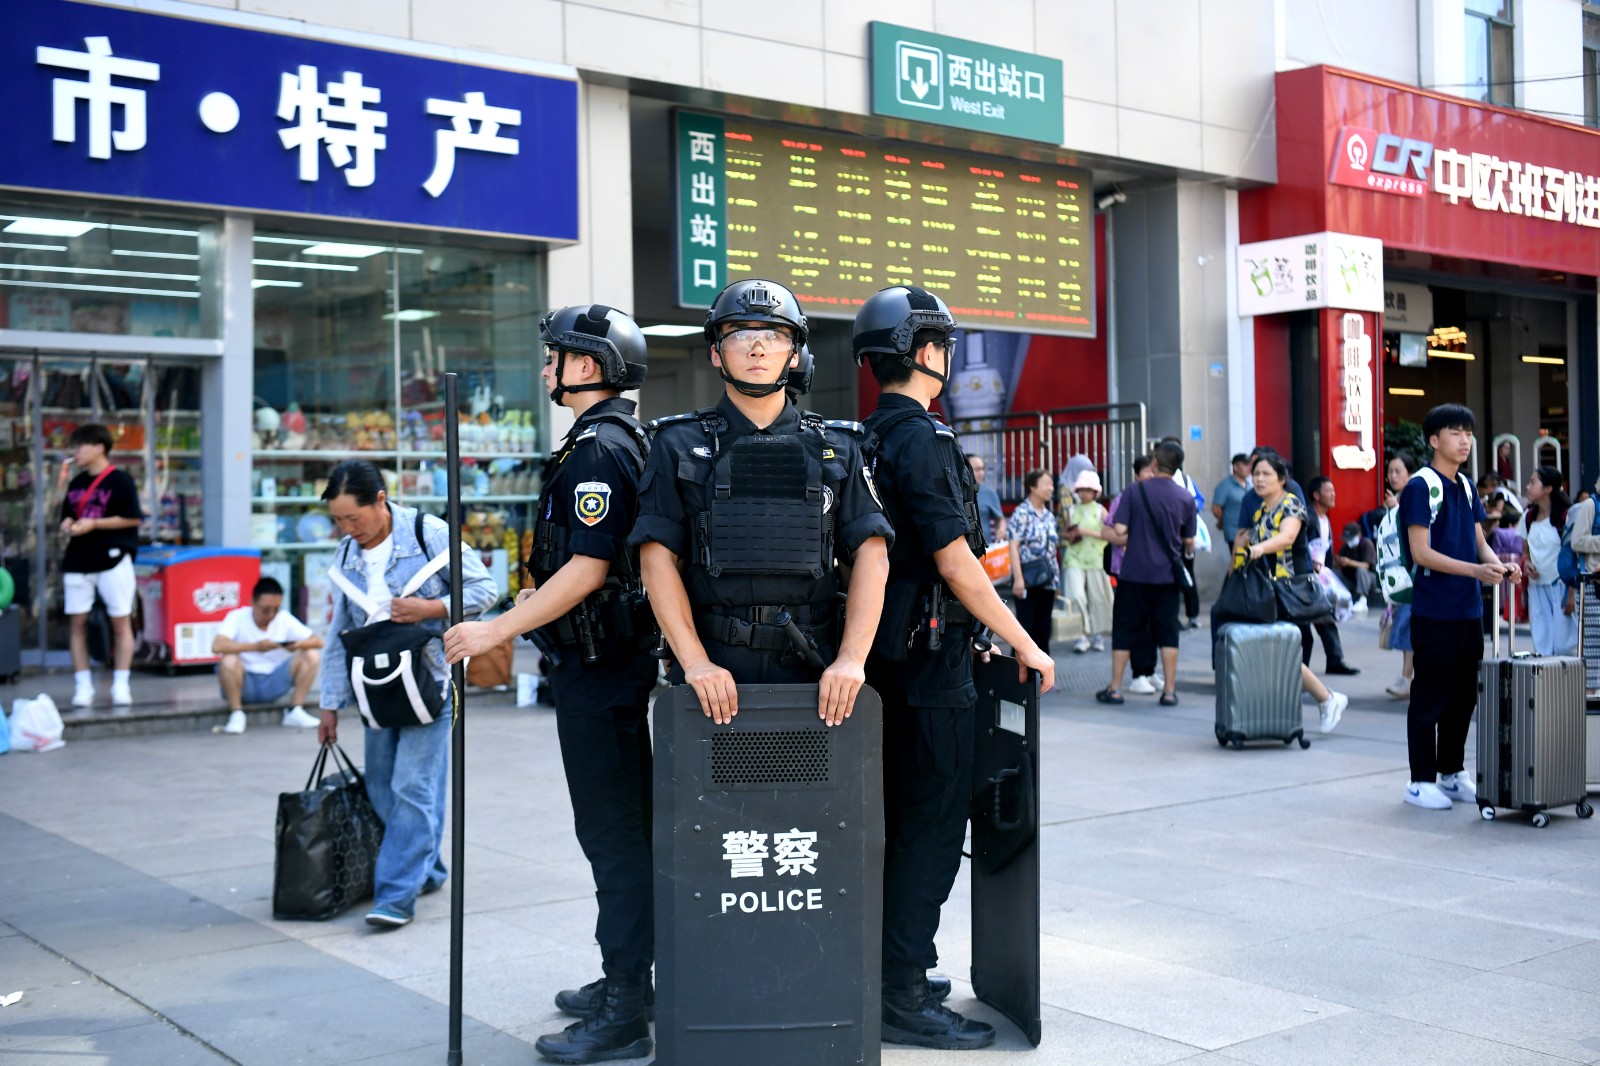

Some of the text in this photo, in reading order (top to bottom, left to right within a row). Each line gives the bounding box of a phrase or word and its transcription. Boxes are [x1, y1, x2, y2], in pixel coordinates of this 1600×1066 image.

[947, 53, 1045, 102] 西出站口
[950, 95, 1006, 120] West Exit
[1367, 174, 1424, 195] express
[688, 130, 718, 289] 西出站口
[722, 827, 820, 878] 警察
[720, 888, 823, 914] POLICE
